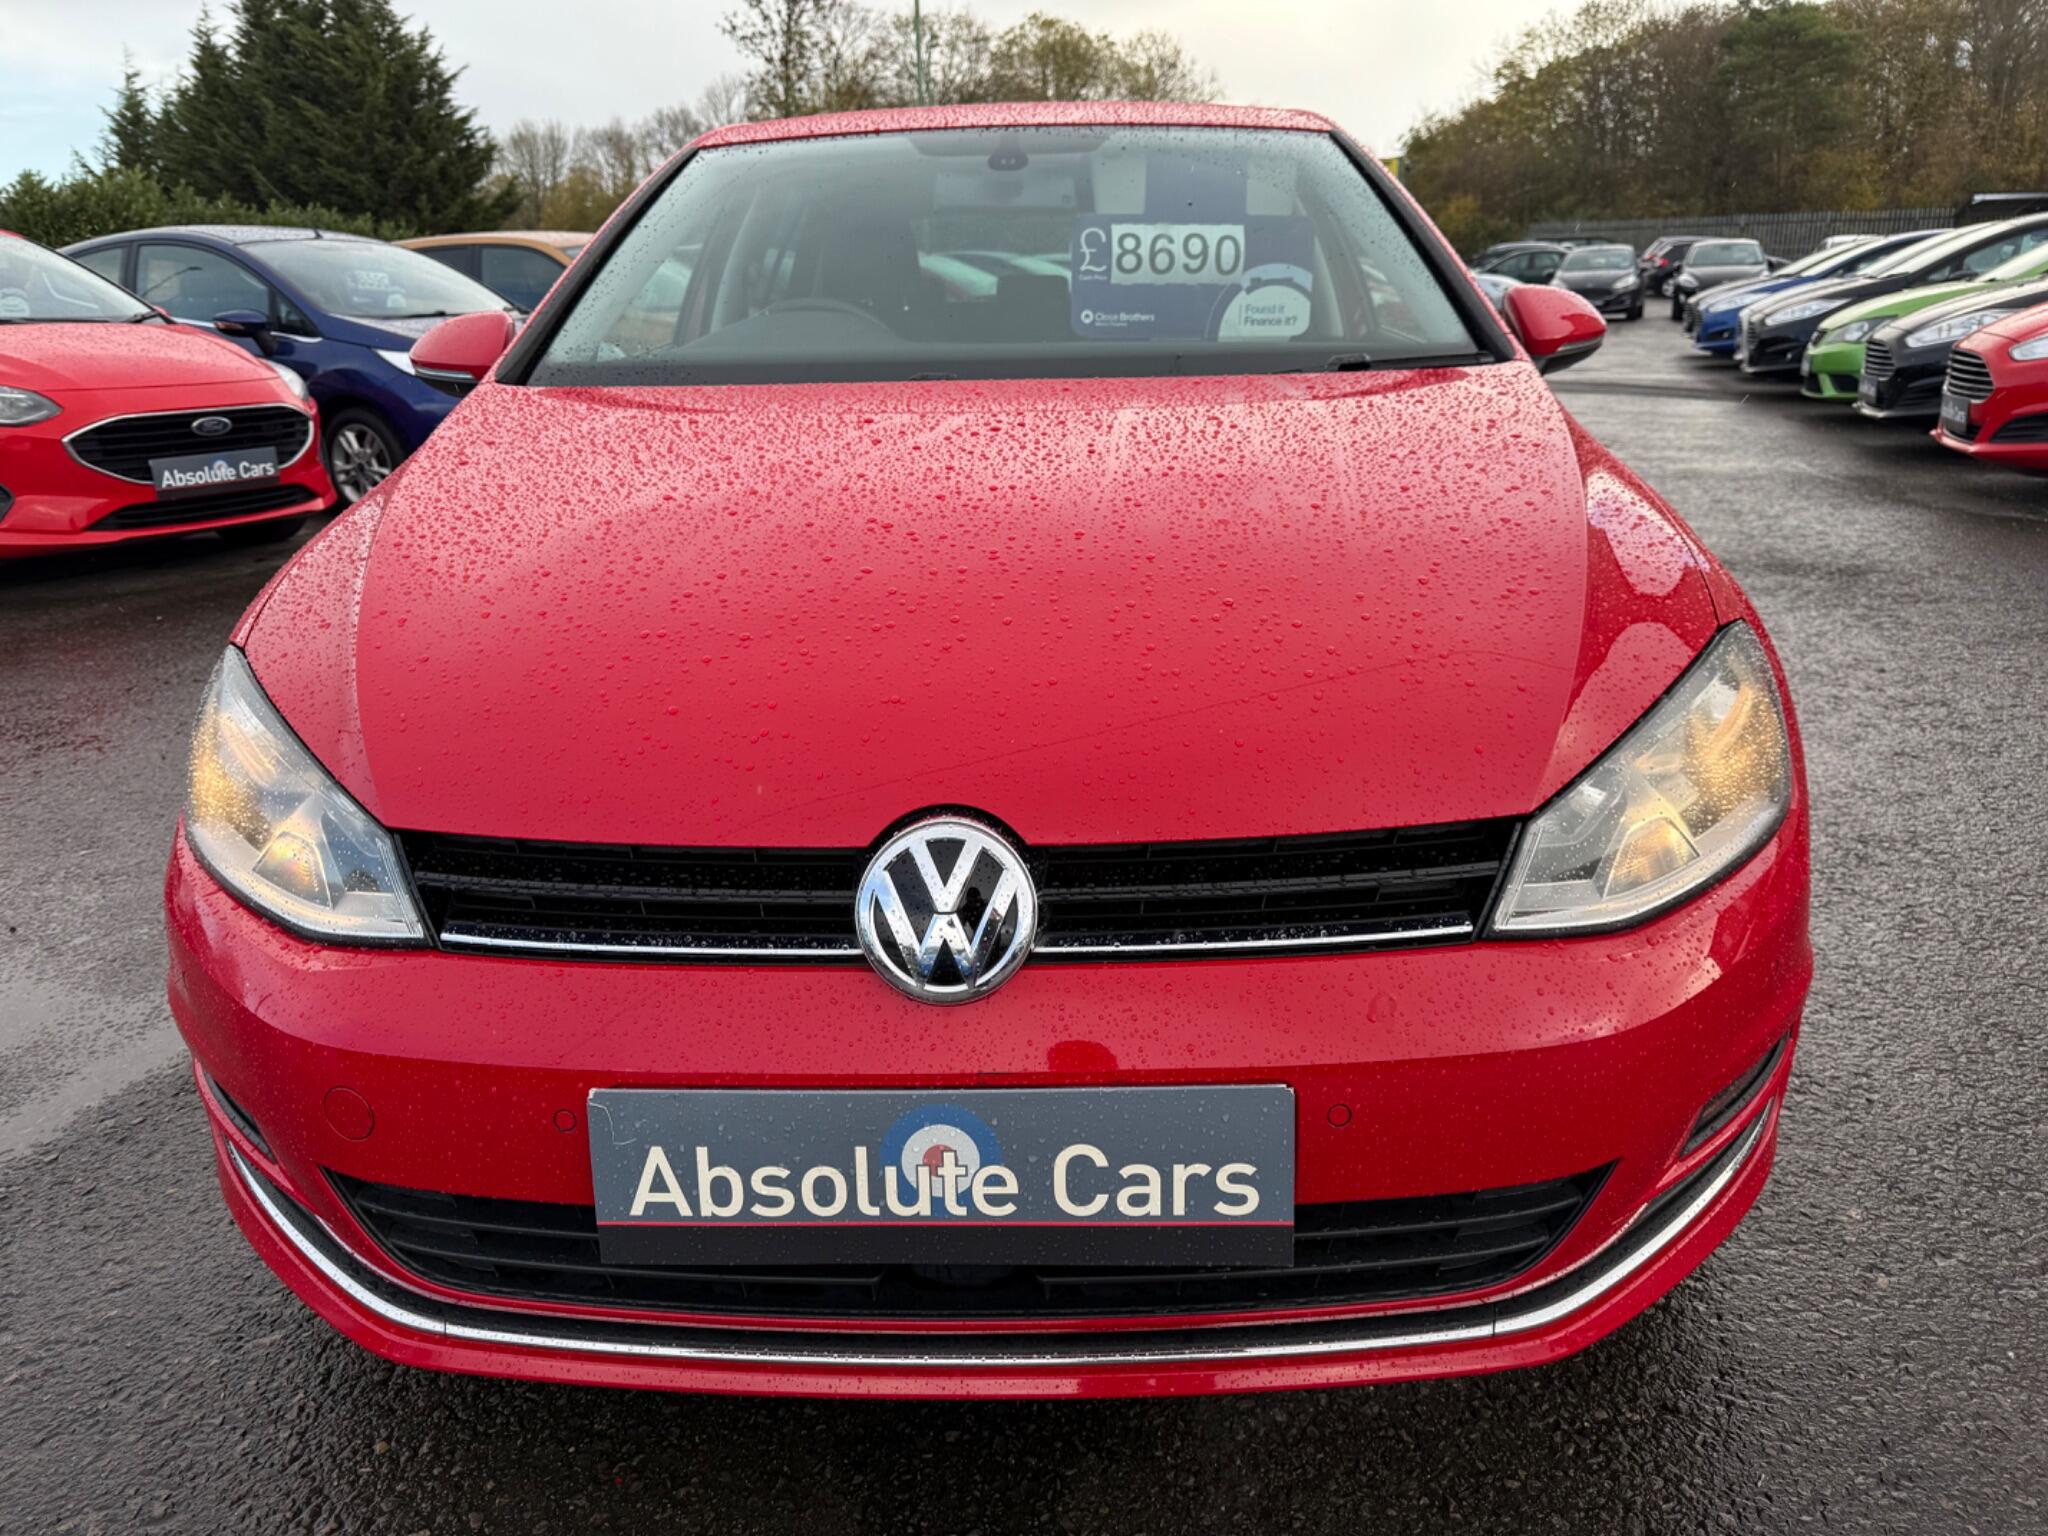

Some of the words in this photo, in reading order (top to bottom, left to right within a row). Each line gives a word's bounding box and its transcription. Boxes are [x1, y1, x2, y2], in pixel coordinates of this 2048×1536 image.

[1245, 304, 1276, 314] Found
[1120, 312, 1155, 321] Brothers
[1244, 316, 1282, 326] Finance
[1284, 316, 1297, 326] it?
[162, 466, 236, 488] Absolute
[239, 461, 275, 478] Cars
[629, 1146, 1018, 1217] Absolute
[1053, 1143, 1260, 1217] Cars
